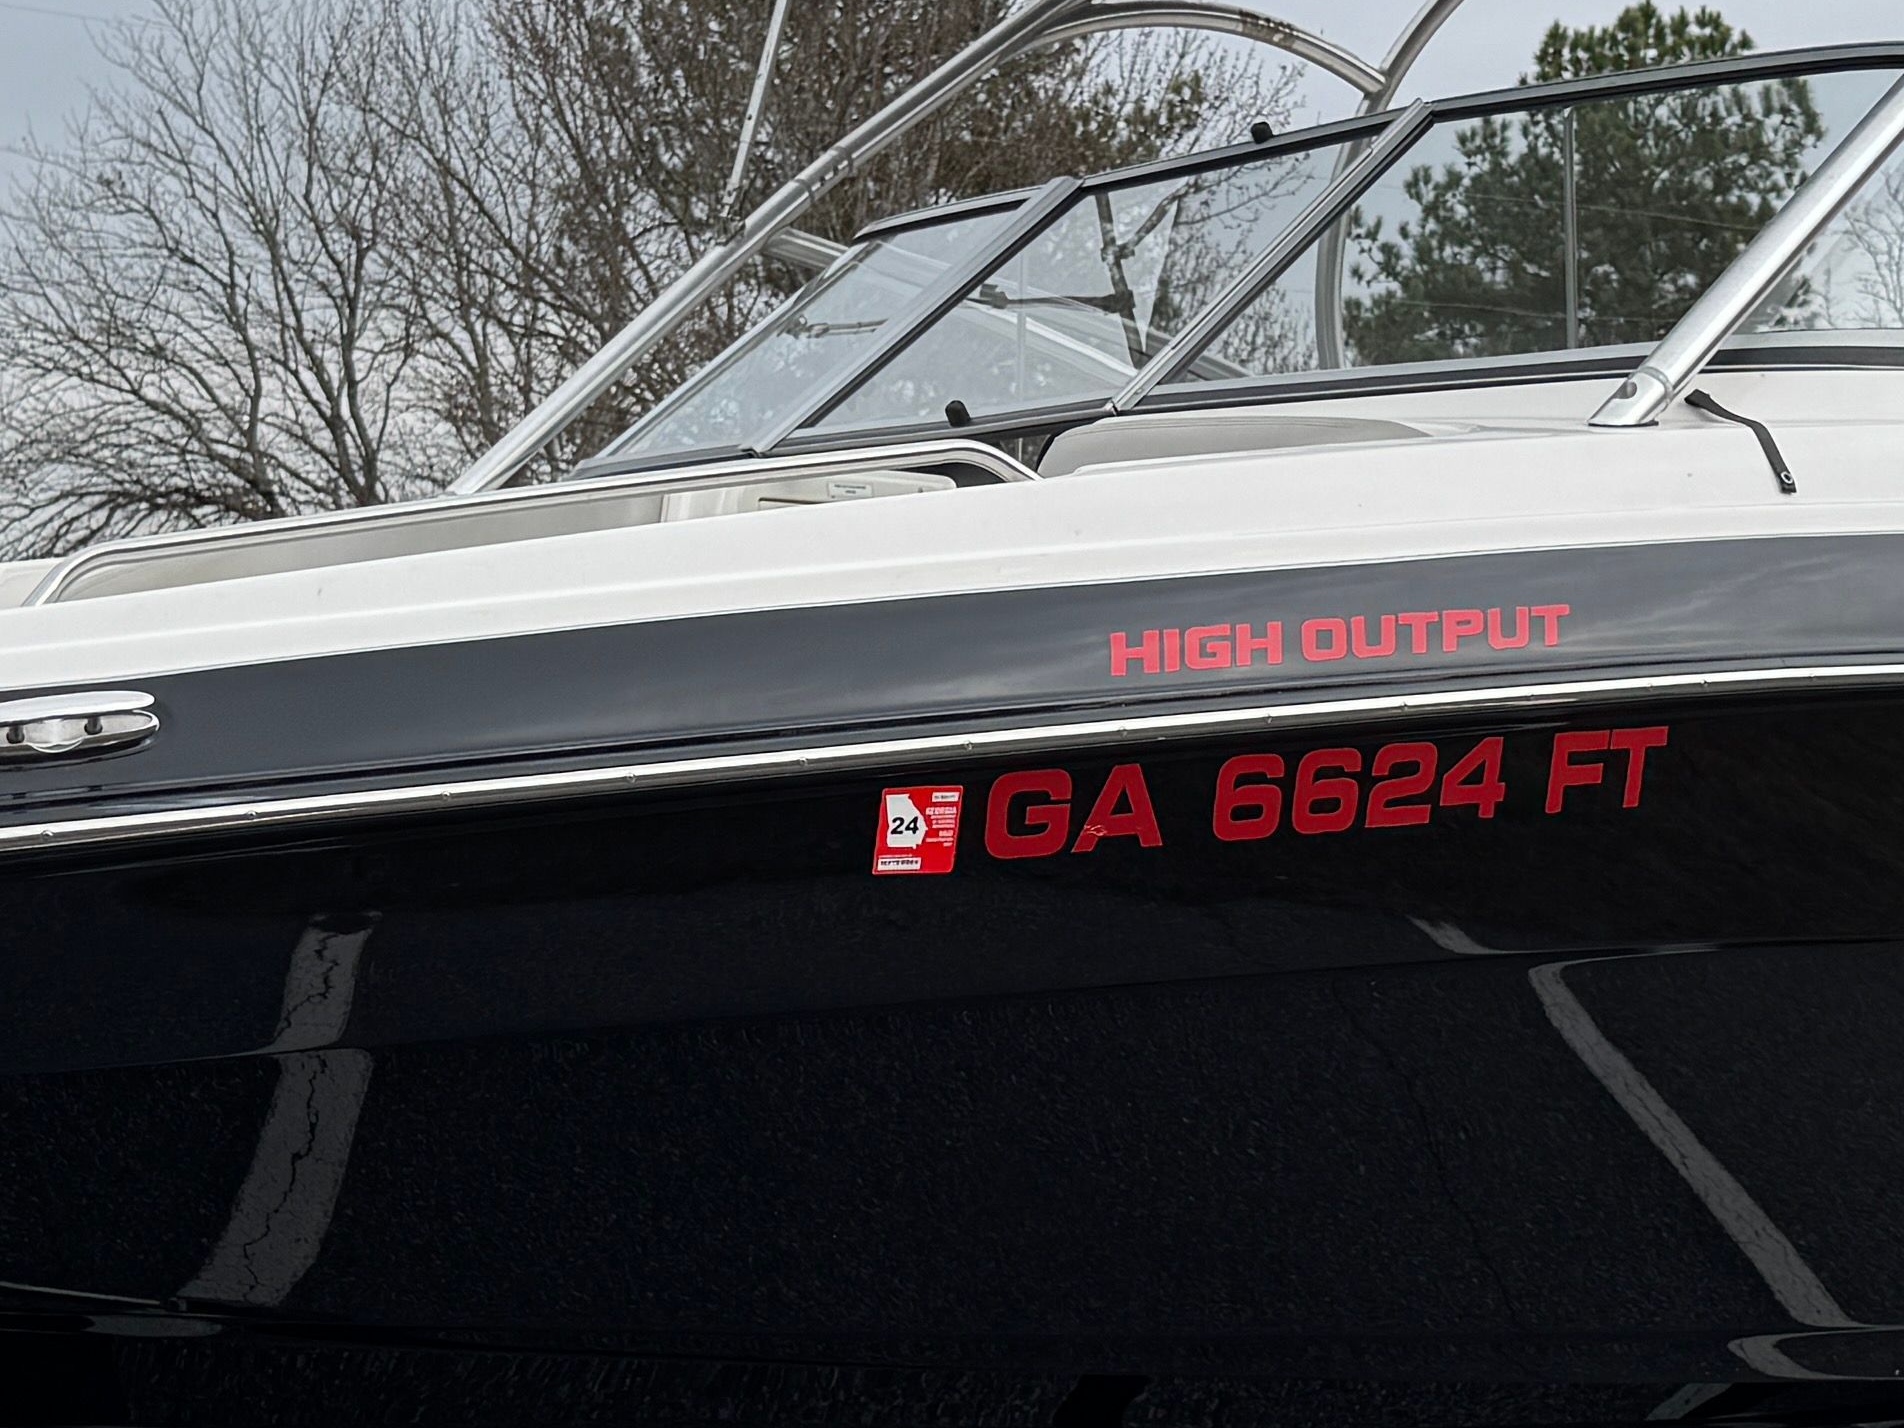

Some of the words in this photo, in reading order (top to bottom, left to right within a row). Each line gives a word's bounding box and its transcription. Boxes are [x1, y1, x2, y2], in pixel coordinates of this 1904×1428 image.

[1110, 620, 1283, 676] HIGH
[1300, 604, 1571, 662] OUTPUT
[890, 816, 919, 835] 24
[984, 762, 1163, 859] GA
[1212, 736, 1506, 842] 6624
[1545, 725, 1670, 815] FT
